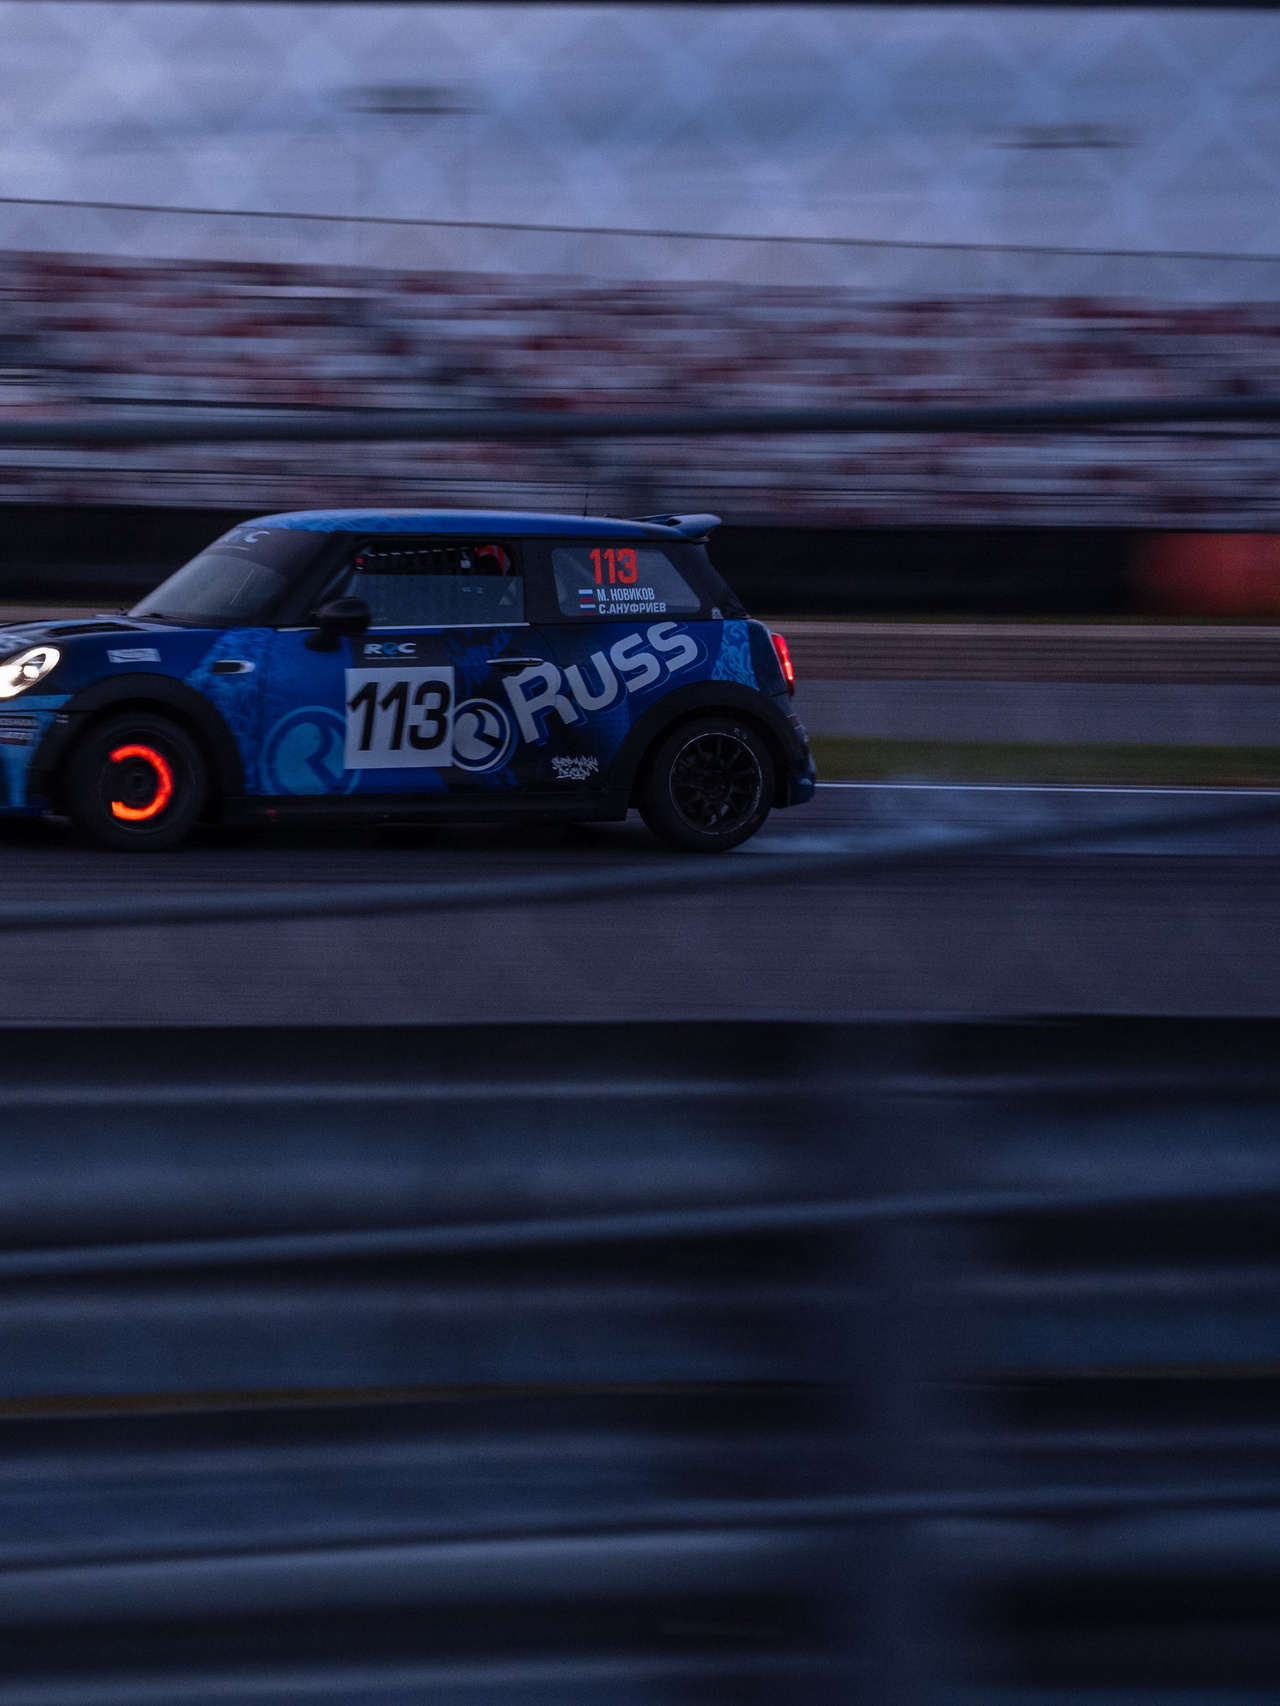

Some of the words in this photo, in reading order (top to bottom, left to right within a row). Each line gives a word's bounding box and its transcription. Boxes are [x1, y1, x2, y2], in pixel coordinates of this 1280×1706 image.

[589, 548, 638, 585] 113
[596, 588, 609, 602] М.
[610, 587, 655, 602] НОВИКОВ
[346, 680, 451, 752] 113
